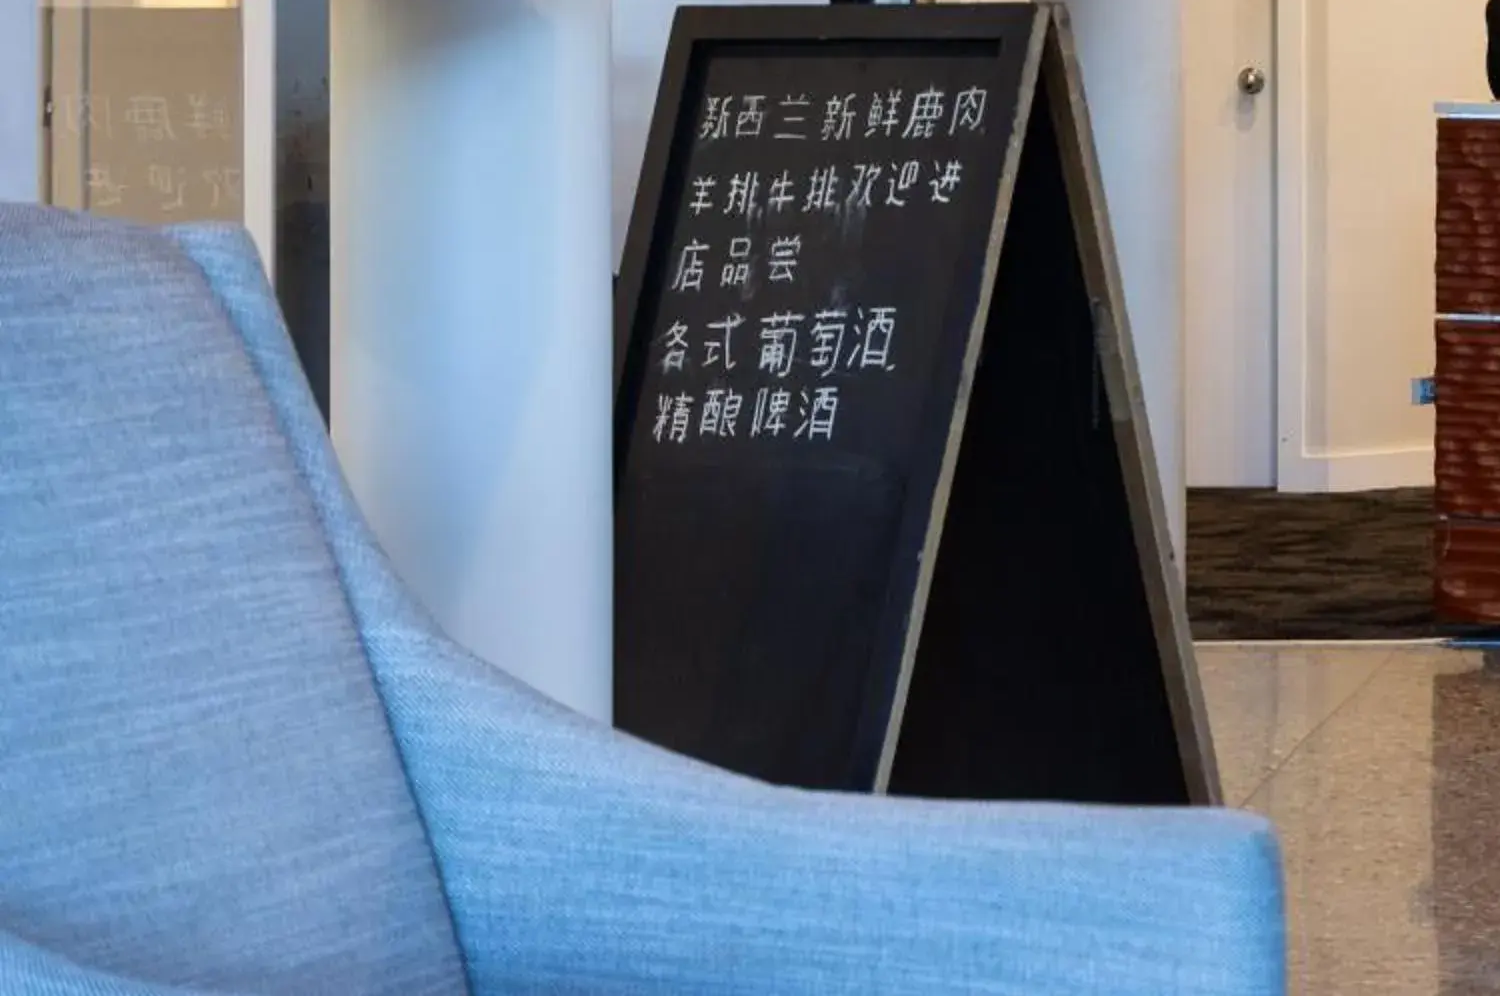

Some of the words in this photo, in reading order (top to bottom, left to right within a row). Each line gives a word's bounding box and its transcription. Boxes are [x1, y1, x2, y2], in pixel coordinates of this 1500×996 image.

[672, 235, 800, 292] 店品尝
[652, 385, 838, 443] 精酿啤酒
